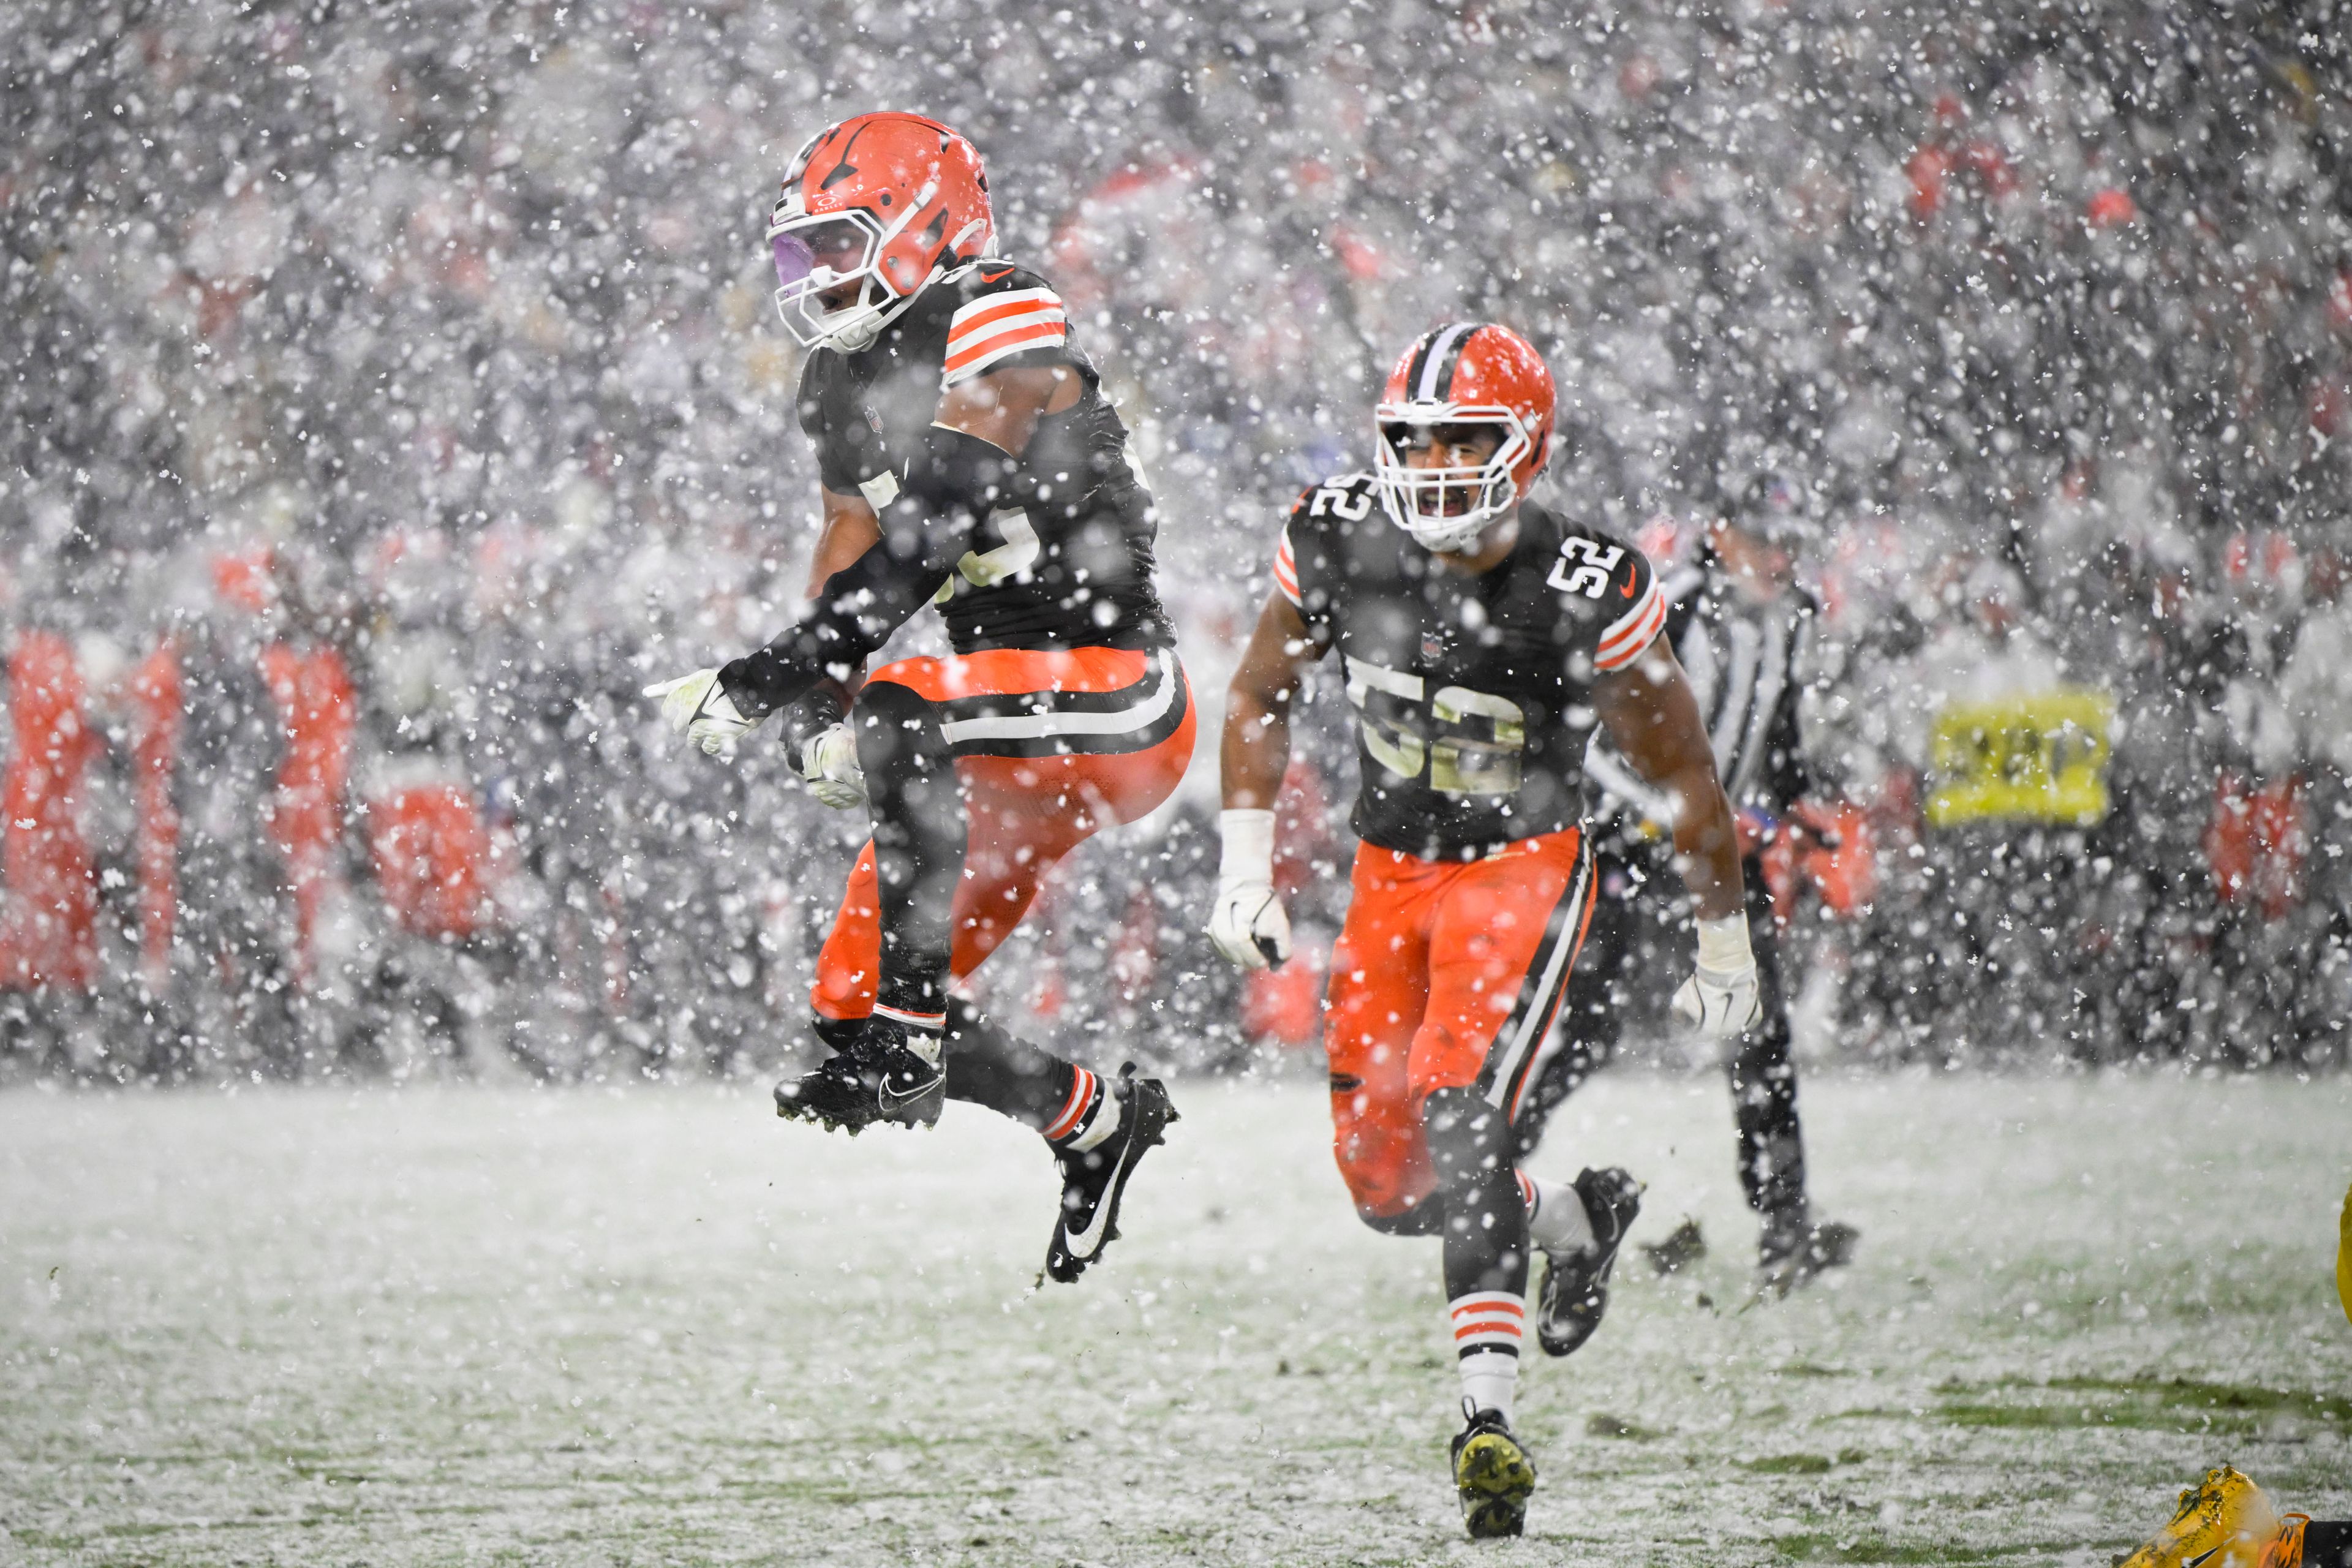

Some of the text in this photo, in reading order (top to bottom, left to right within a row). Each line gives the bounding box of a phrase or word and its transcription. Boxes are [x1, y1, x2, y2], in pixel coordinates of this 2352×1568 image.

[814, 202, 843, 213] OAKLEY
[1310, 471, 1379, 521] 52
[1547, 536, 1624, 599] 52
[1345, 654, 1525, 794] 52
